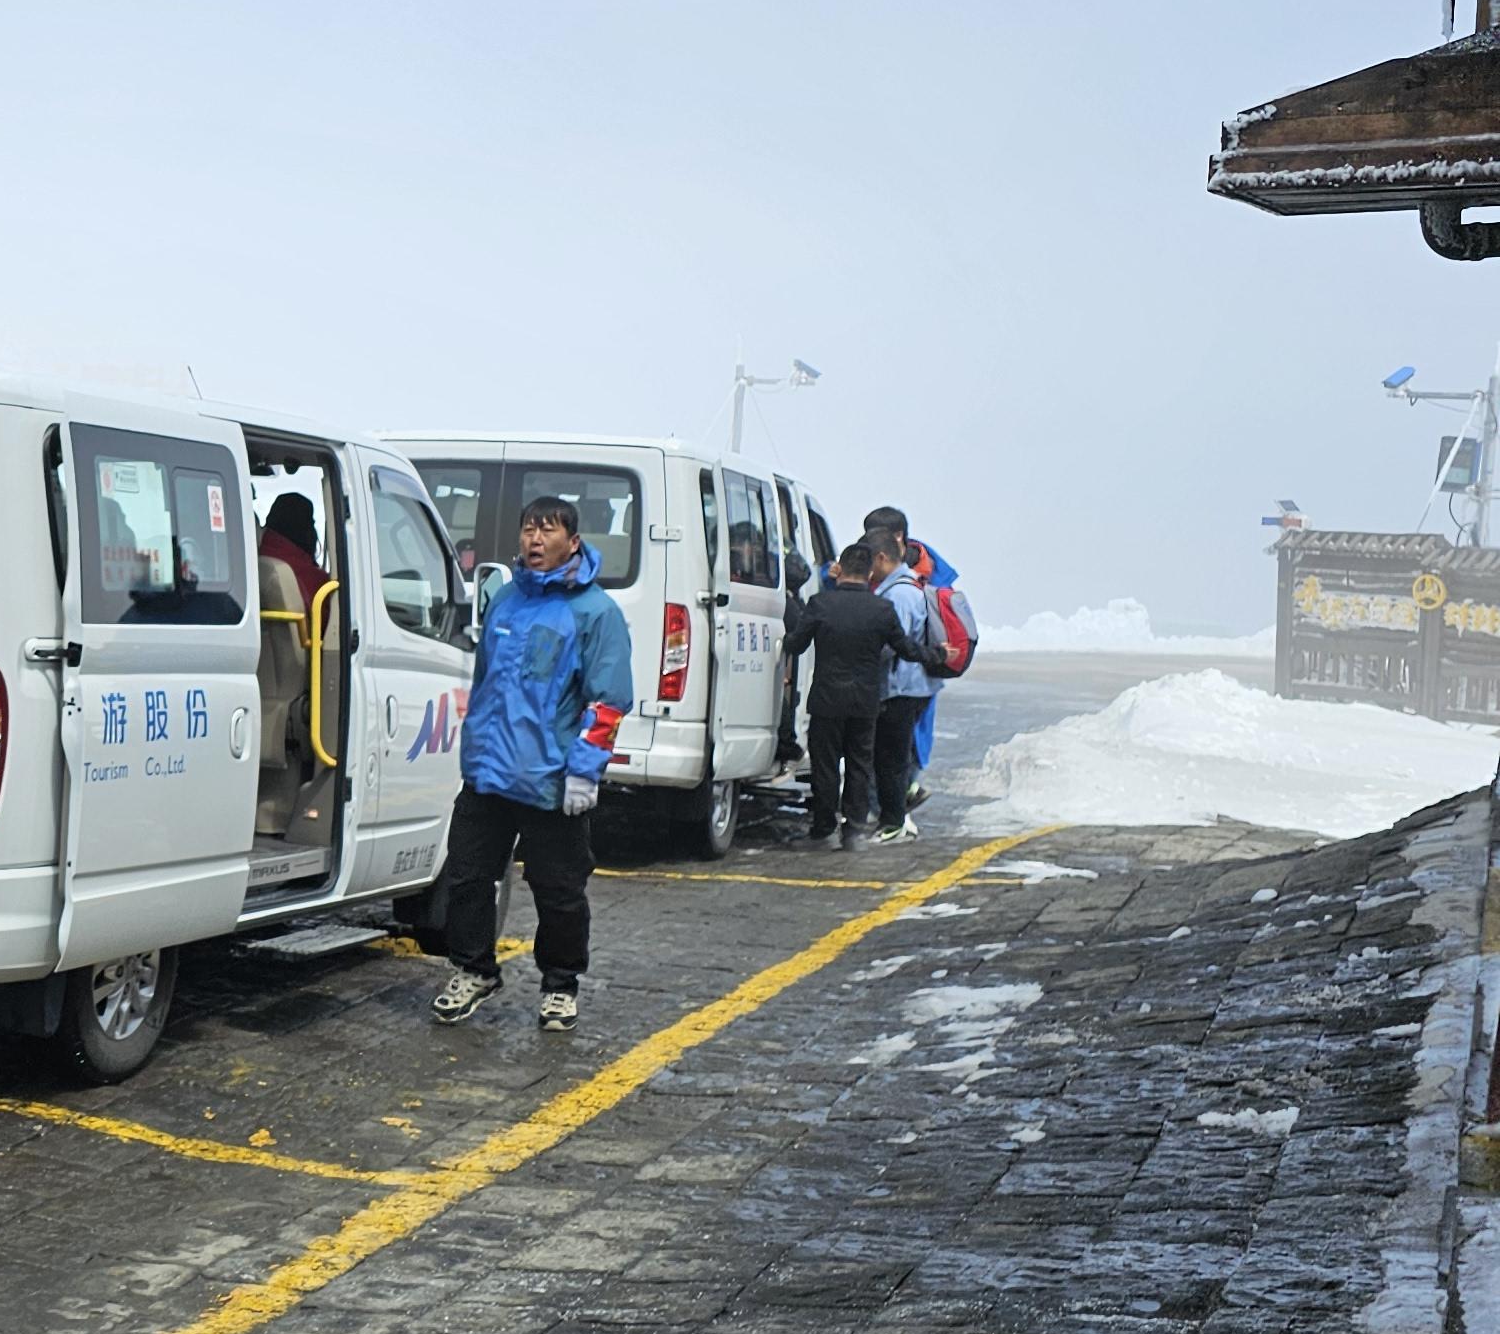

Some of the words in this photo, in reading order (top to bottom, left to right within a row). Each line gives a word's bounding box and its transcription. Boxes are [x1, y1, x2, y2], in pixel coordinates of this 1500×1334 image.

[101, 689, 208, 745] 游股份
[84, 761, 129, 783] Tourism
